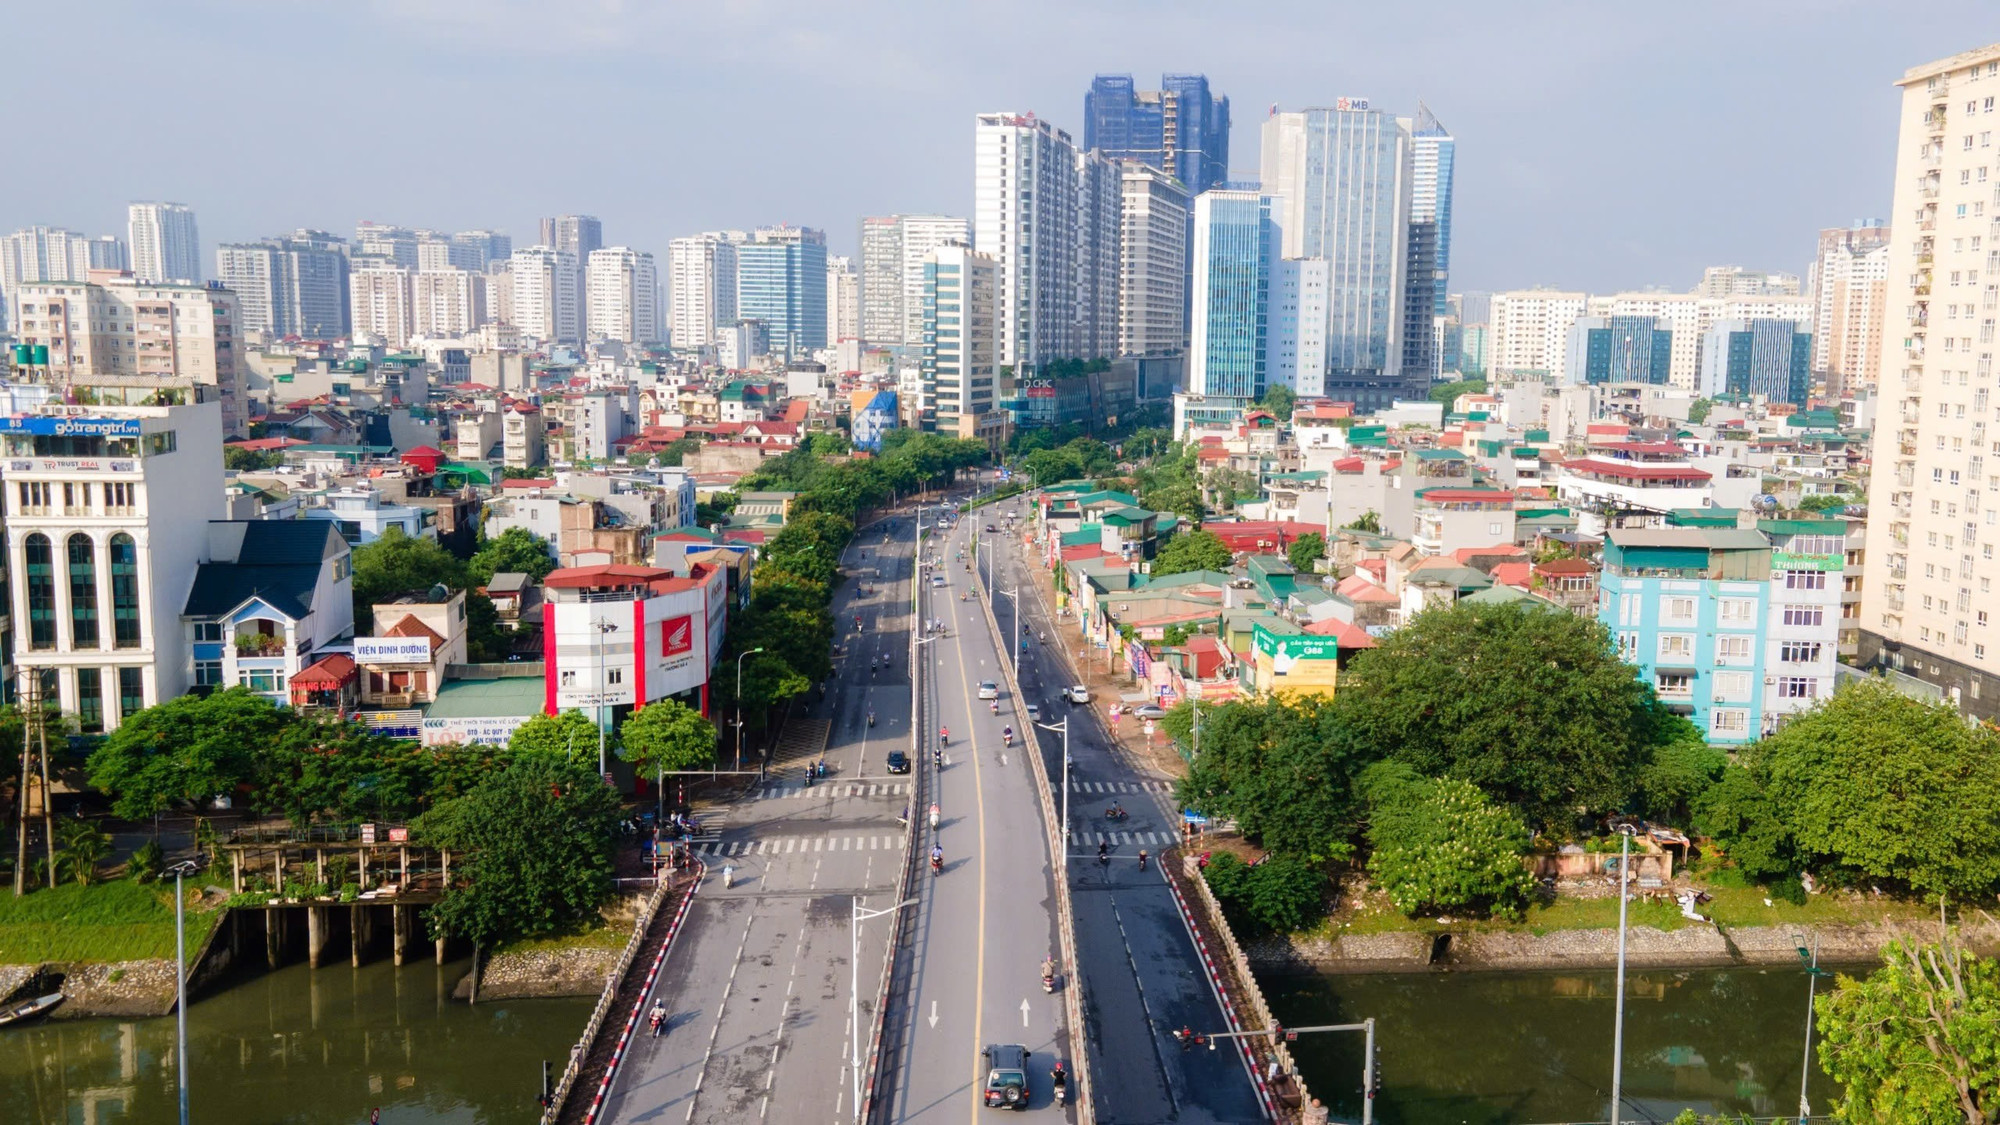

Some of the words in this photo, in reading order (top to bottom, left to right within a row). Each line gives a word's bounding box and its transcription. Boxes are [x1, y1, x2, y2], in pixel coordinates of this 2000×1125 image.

[1351, 100, 1368, 110] MB
[1023, 379, 1053, 388] D.CHIC
[9, 419, 22, 428] 85
[357, 645, 377, 655] VIỆN
[378, 645, 398, 654] DINH
